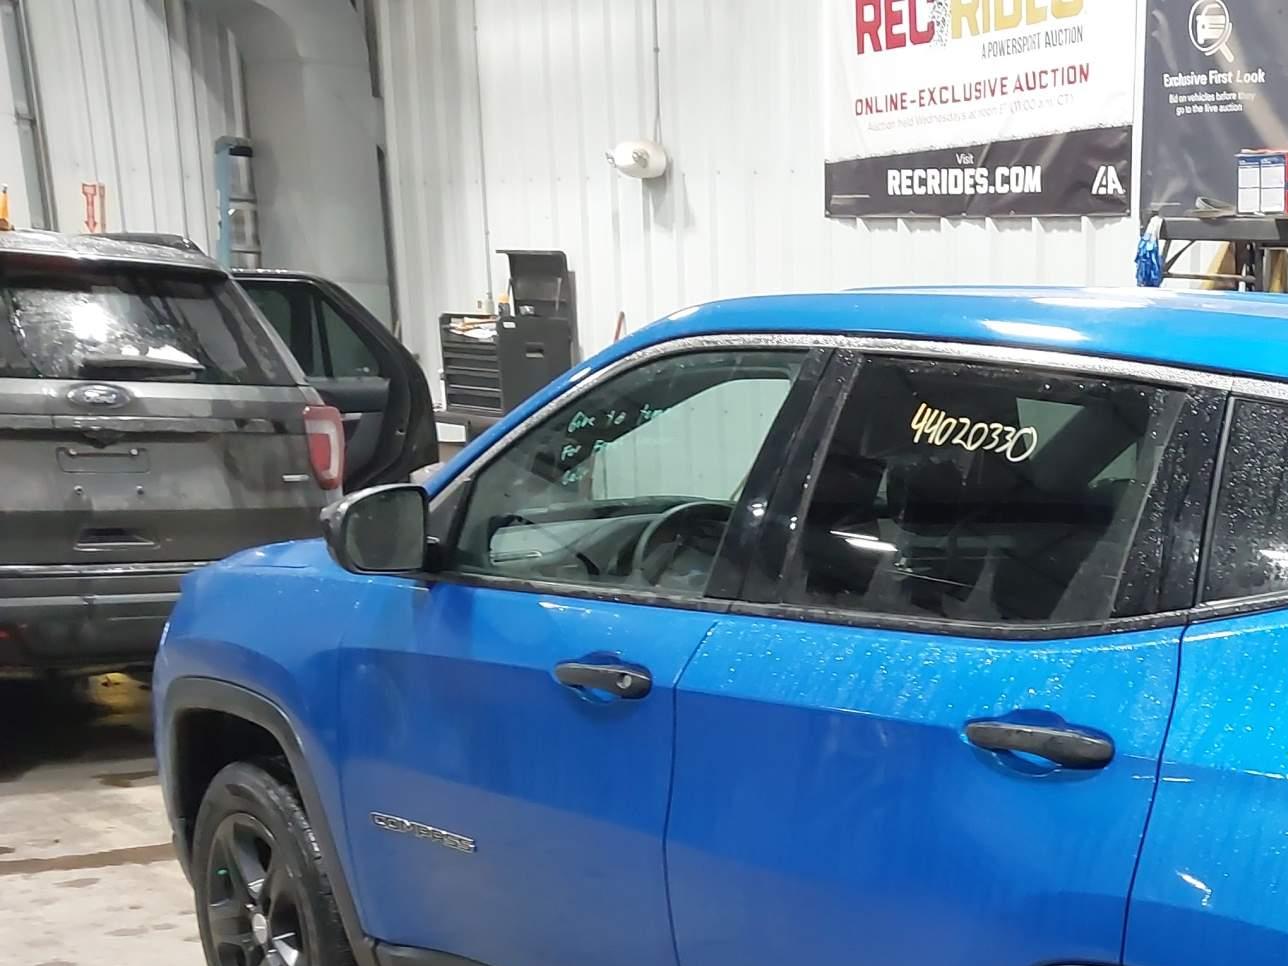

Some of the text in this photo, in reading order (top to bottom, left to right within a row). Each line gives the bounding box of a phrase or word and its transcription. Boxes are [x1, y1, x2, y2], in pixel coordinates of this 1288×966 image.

[855, 0, 935, 55] REC
[988, 32, 1041, 58] POWERSPORT
[1044, 24, 1084, 48] AUCTION
[855, 76, 1008, 116] ONLINE-EXCLUSIVE
[1012, 63, 1090, 93] AUCTION
[1163, 68, 1266, 87] Exclusive First Look
[1176, 103, 1243, 116] go to the live auction
[1179, 95, 1186, 103] on
[1187, 93, 1215, 102] vehicles
[1216, 91, 1237, 100] before
[955, 153, 974, 165] Visit
[887, 166, 1042, 195] RECRIDES.COM
[911, 402, 1038, 462] 44020330
